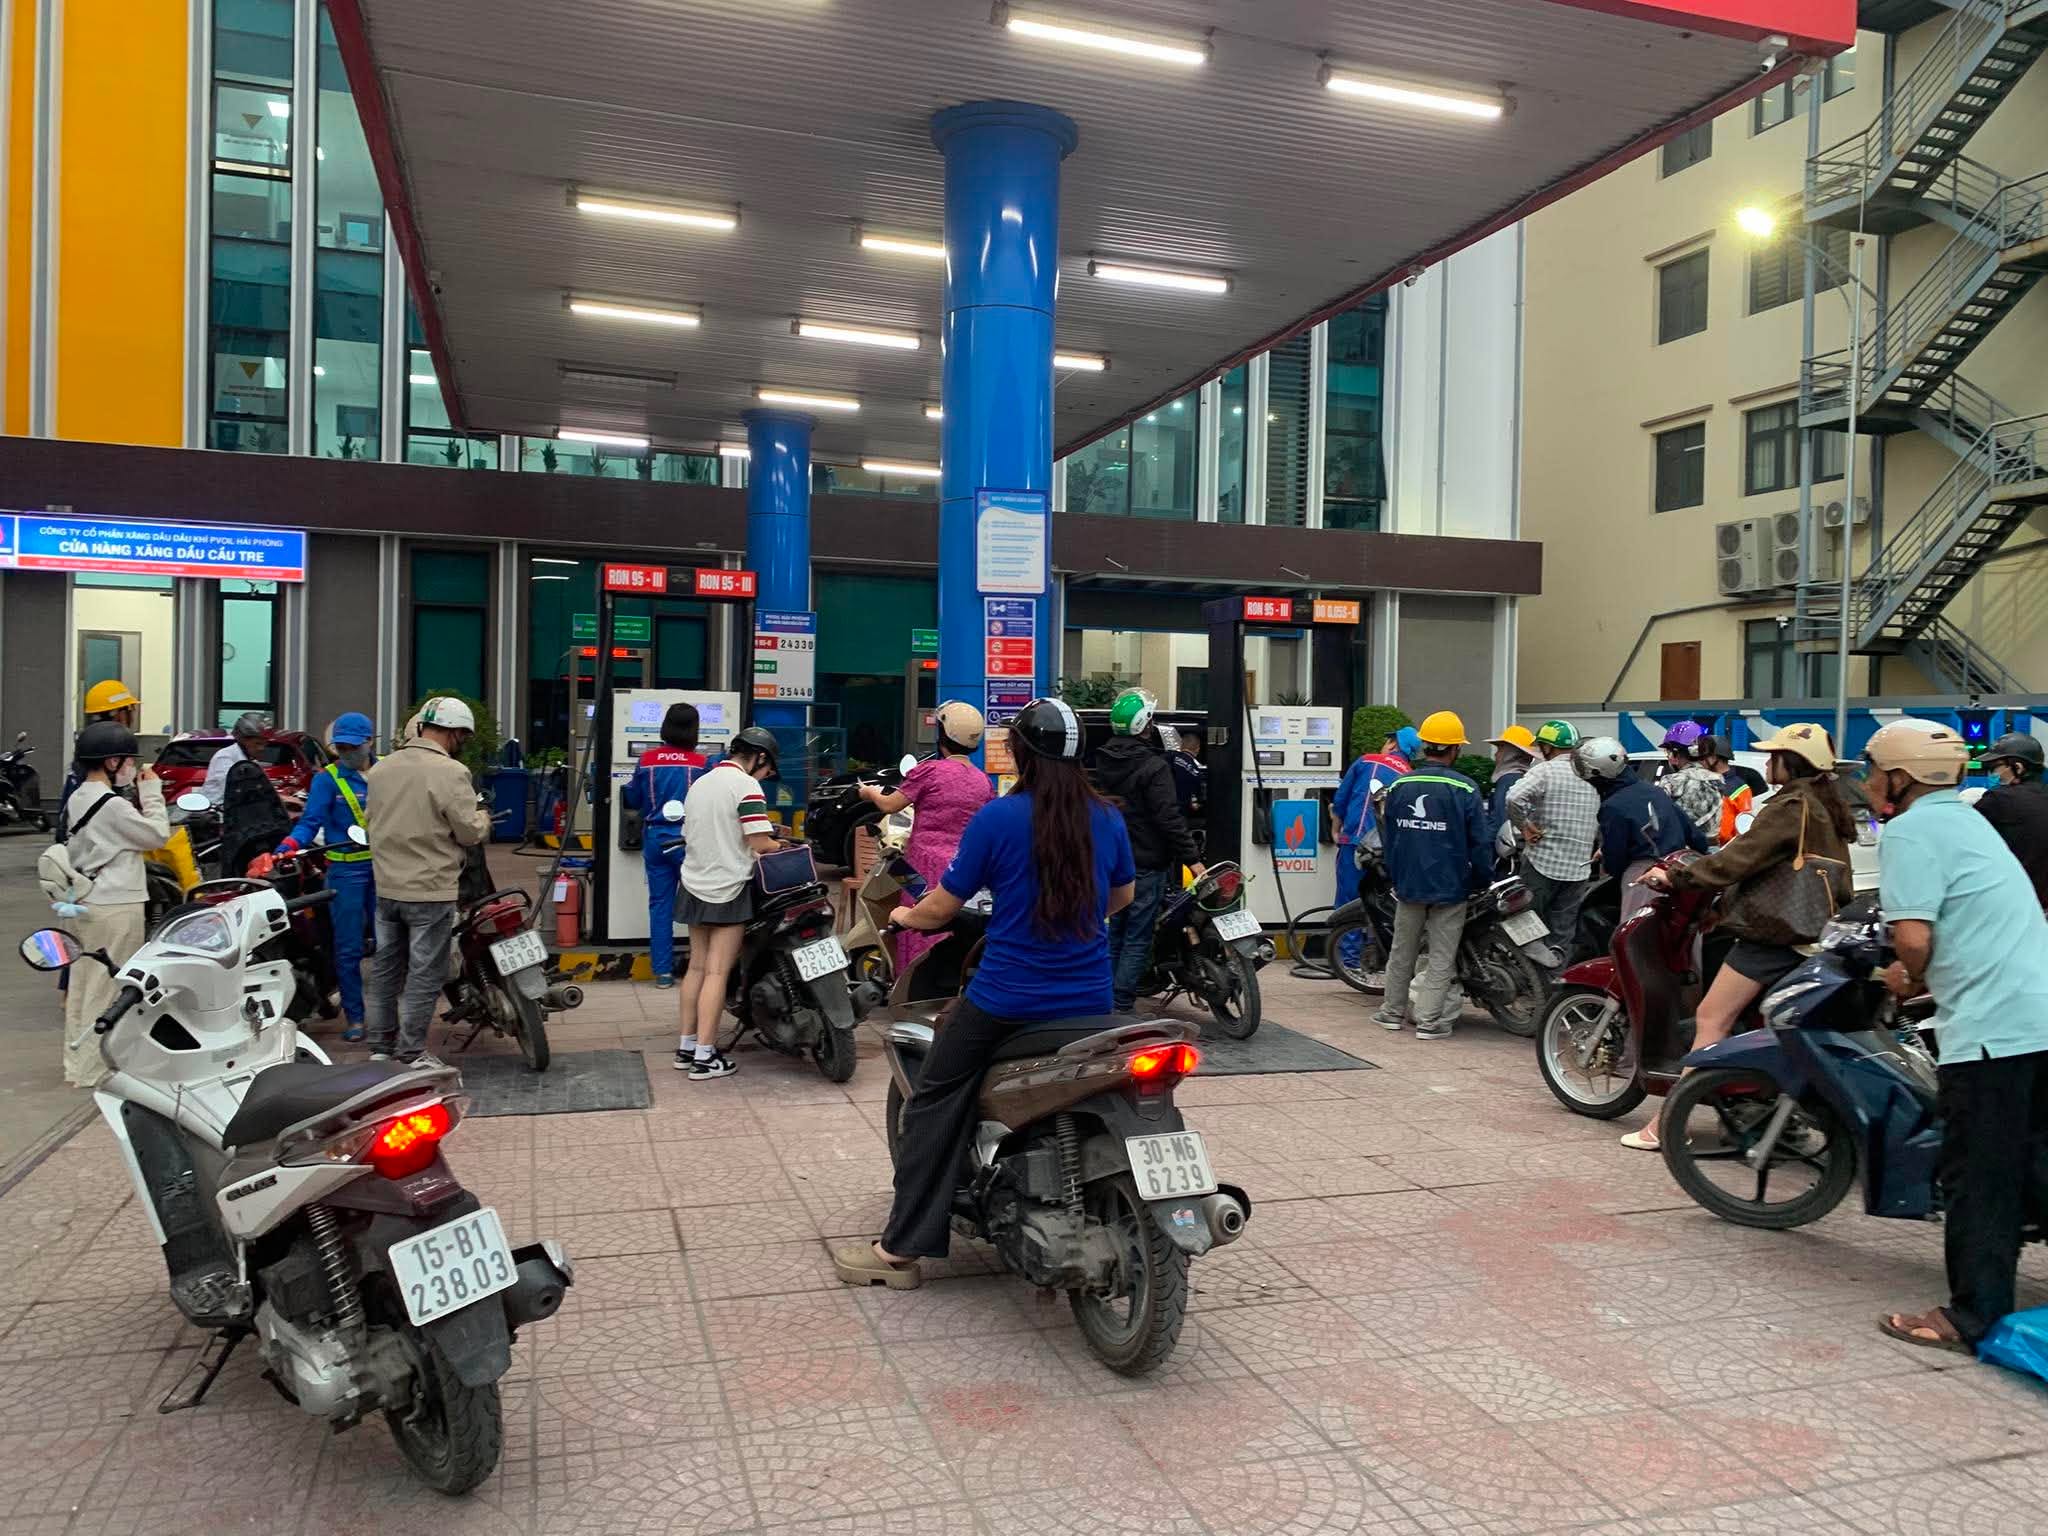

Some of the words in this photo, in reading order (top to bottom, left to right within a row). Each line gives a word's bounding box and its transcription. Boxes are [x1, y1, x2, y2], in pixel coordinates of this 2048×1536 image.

[39, 526, 67, 536] CÔNG
[69, 528, 81, 536] TY
[210, 536, 234, 545] PVOIL
[59, 538, 88, 553] CỬA
[92, 541, 131, 556] HÀNG
[135, 543, 173, 558] XĂNG
[177, 544, 205, 560] DẦU
[208, 547, 235, 561] CẦU
[239, 550, 264, 562] TRE
[608, 569, 629, 585] RON
[631, 571, 644, 586] 95
[652, 572, 663, 587] III
[700, 574, 719, 590] RON
[722, 576, 733, 591] 95
[742, 577, 752, 592] III
[1247, 602, 1263, 615] RON
[1264, 603, 1274, 616] 95
[1280, 603, 1288, 616] III
[781, 639, 814, 650] 24330
[780, 687, 813, 697] 35440
[657, 753, 689, 761] PVOIL
[1396, 818, 1447, 831] VINCONS
[1275, 860, 1314, 871] PVOIL
[1146, 1164, 1205, 1194] 6239
[411, 1219, 487, 1275] 15-B1
[411, 1250, 508, 1317] 238.03
